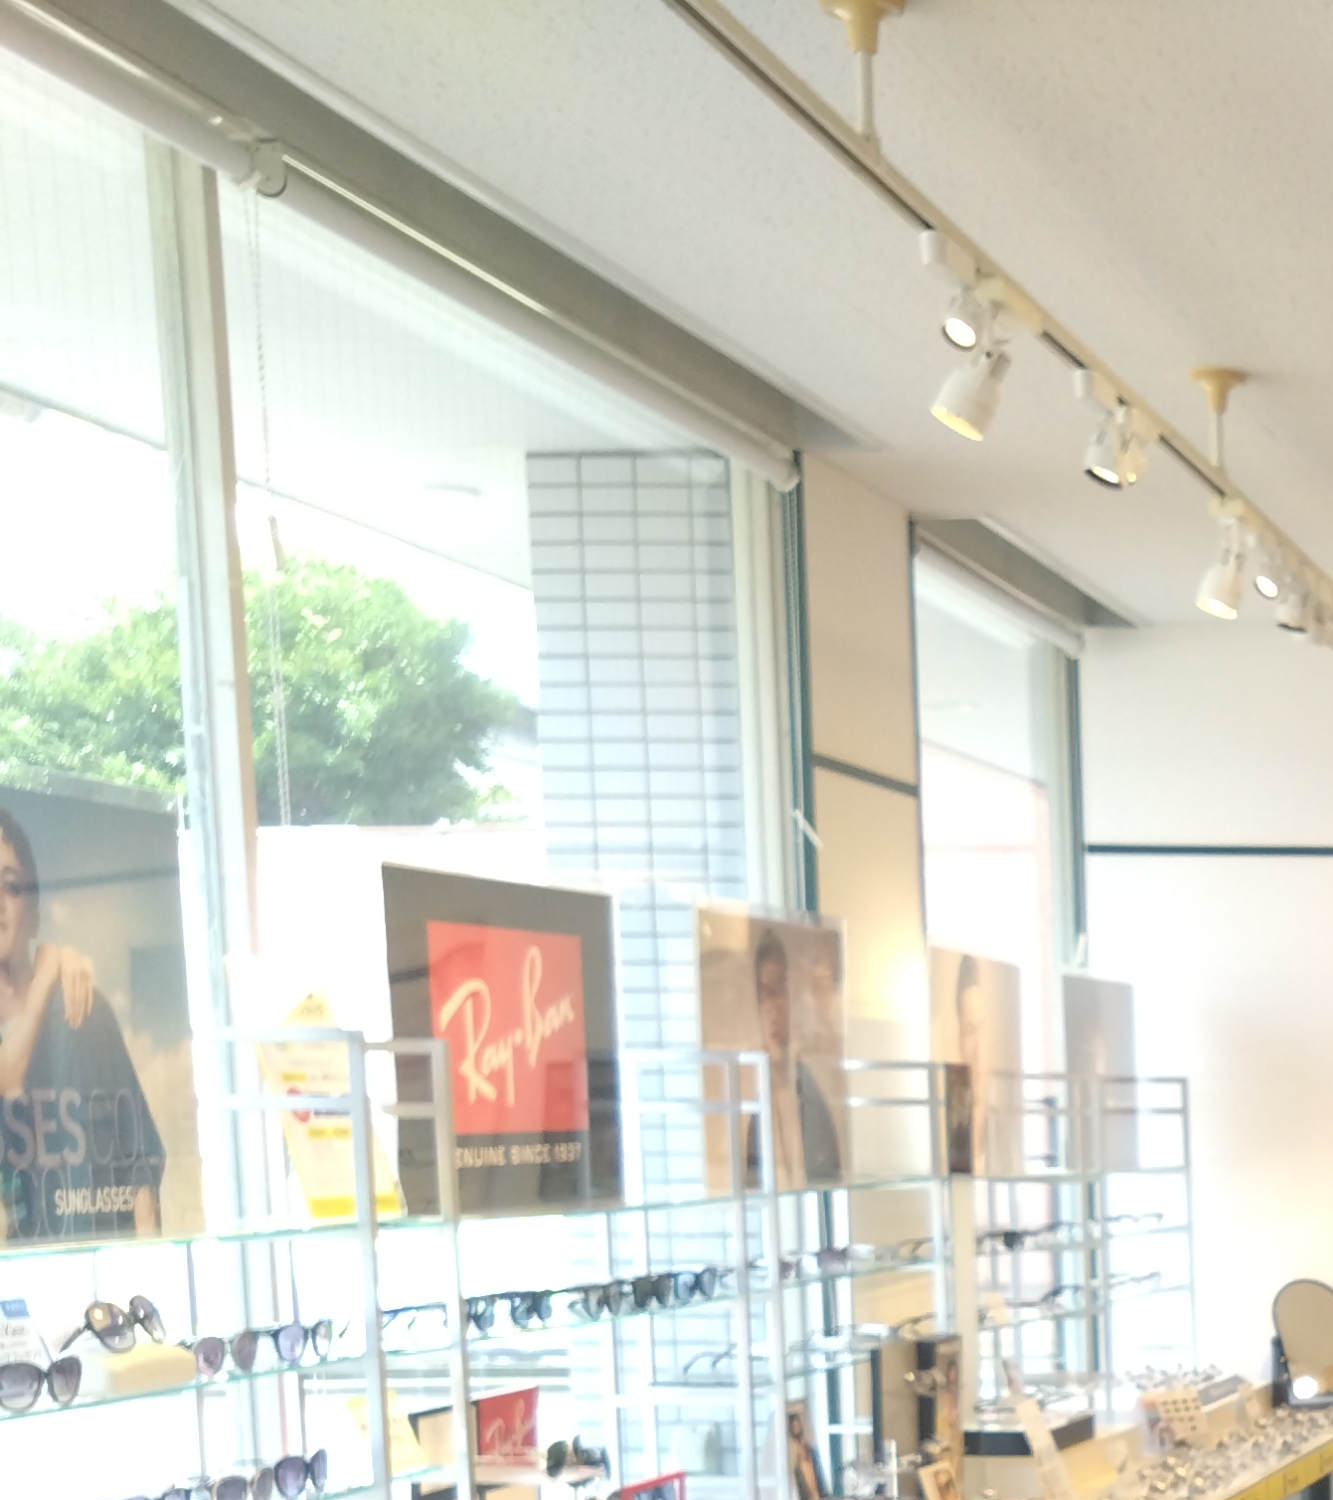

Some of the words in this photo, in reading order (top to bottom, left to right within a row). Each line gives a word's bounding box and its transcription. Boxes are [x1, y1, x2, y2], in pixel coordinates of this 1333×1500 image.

[0, 1088, 87, 1169] SES
[456, 1145, 506, 1170] ENUINE
[55, 1185, 134, 1216] SUNGLASSES
